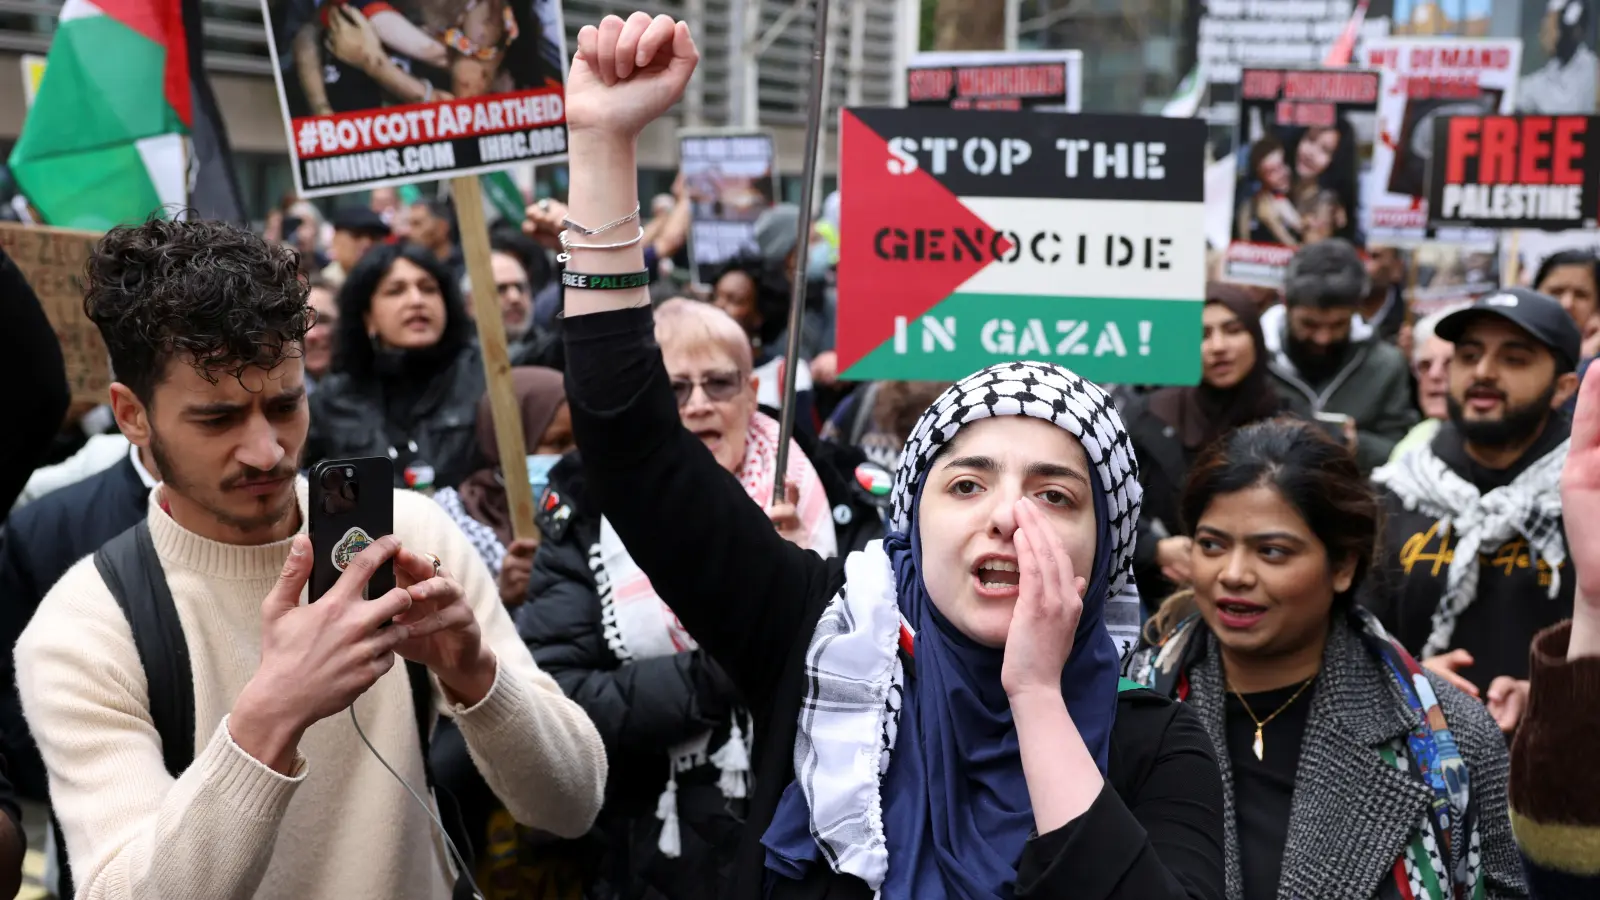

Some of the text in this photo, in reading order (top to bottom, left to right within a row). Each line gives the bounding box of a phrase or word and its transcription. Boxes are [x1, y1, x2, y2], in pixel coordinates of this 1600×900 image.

[299, 93, 564, 155] #BOYCOTTAPARTHEID
[305, 125, 566, 188] INMINDS.COM IHRC.ORG
[886, 136, 1167, 179] STOP THE
[1445, 115, 1588, 185] FREE
[1441, 183, 1583, 220] PALESTINE
[873, 227, 1173, 270] GENOCIDE
[561, 273, 587, 288] FREE
[893, 316, 1153, 358] IN GAZA!
